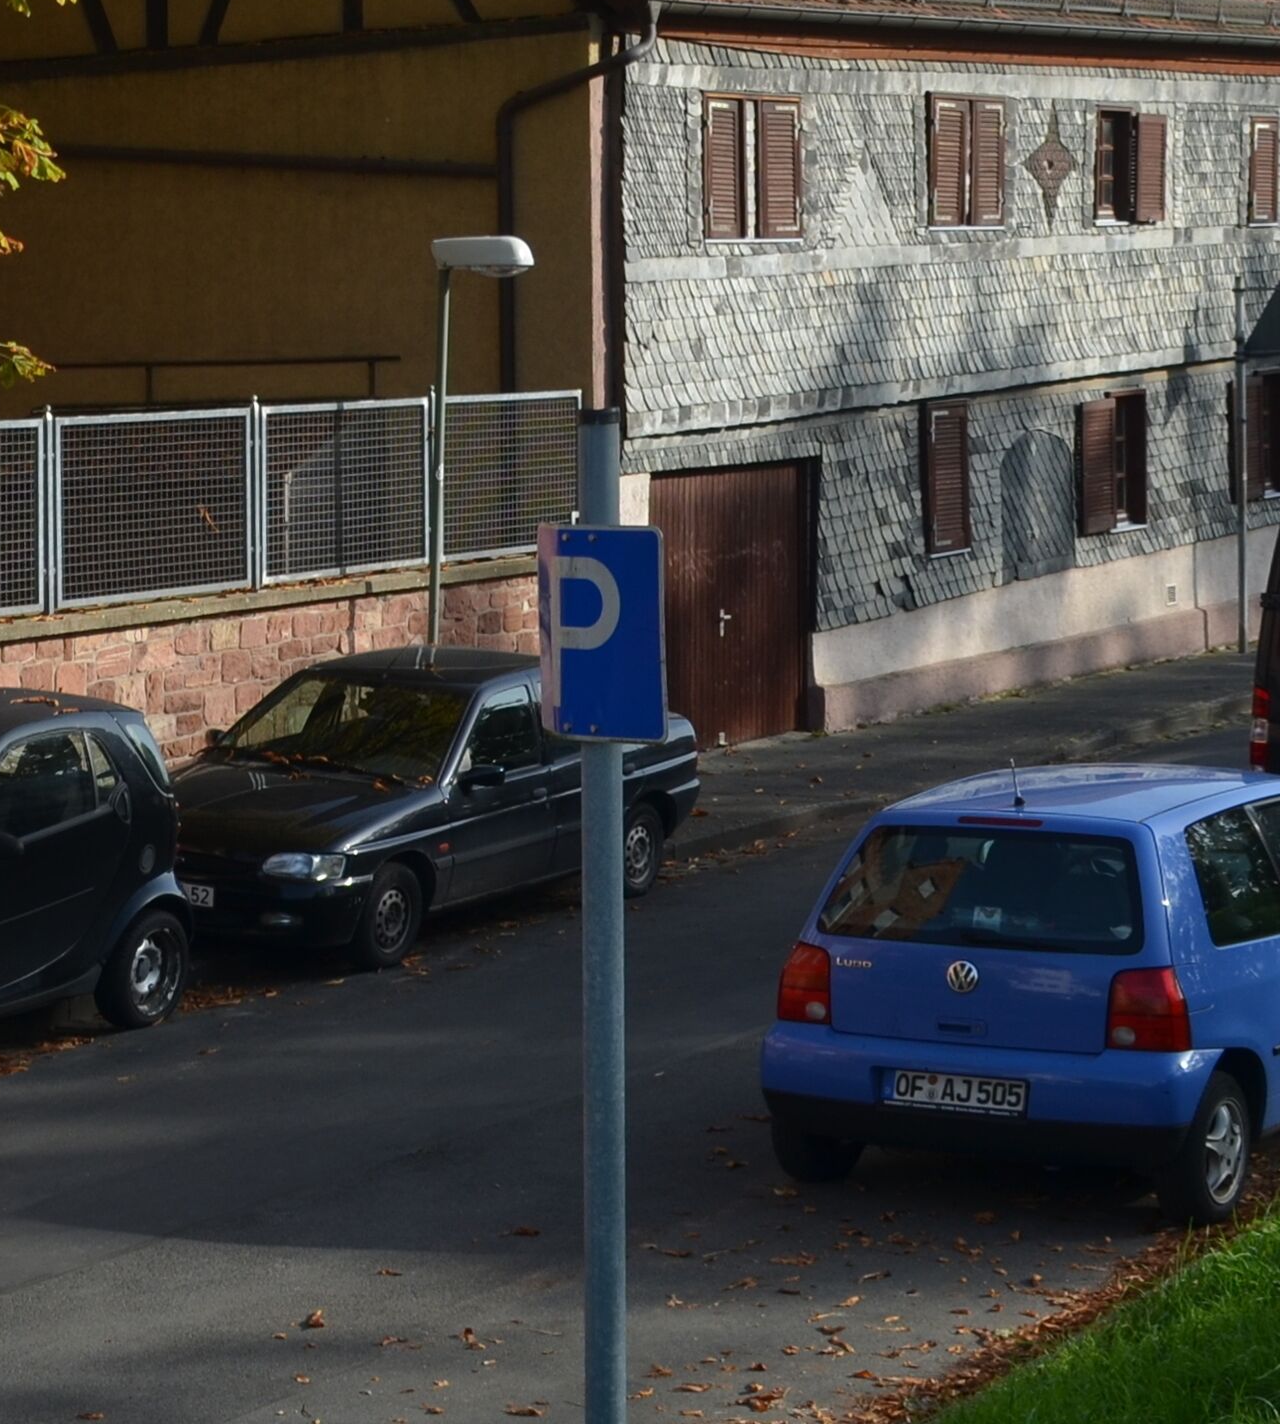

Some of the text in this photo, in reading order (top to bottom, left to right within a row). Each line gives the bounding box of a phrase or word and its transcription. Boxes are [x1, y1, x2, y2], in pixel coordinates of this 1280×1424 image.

[549, 555, 620, 707] P
[191, 886, 210, 905] 52
[895, 1073, 926, 1098] OF
[940, 1077, 973, 1103] AJ
[976, 1080, 1024, 1108] 505
